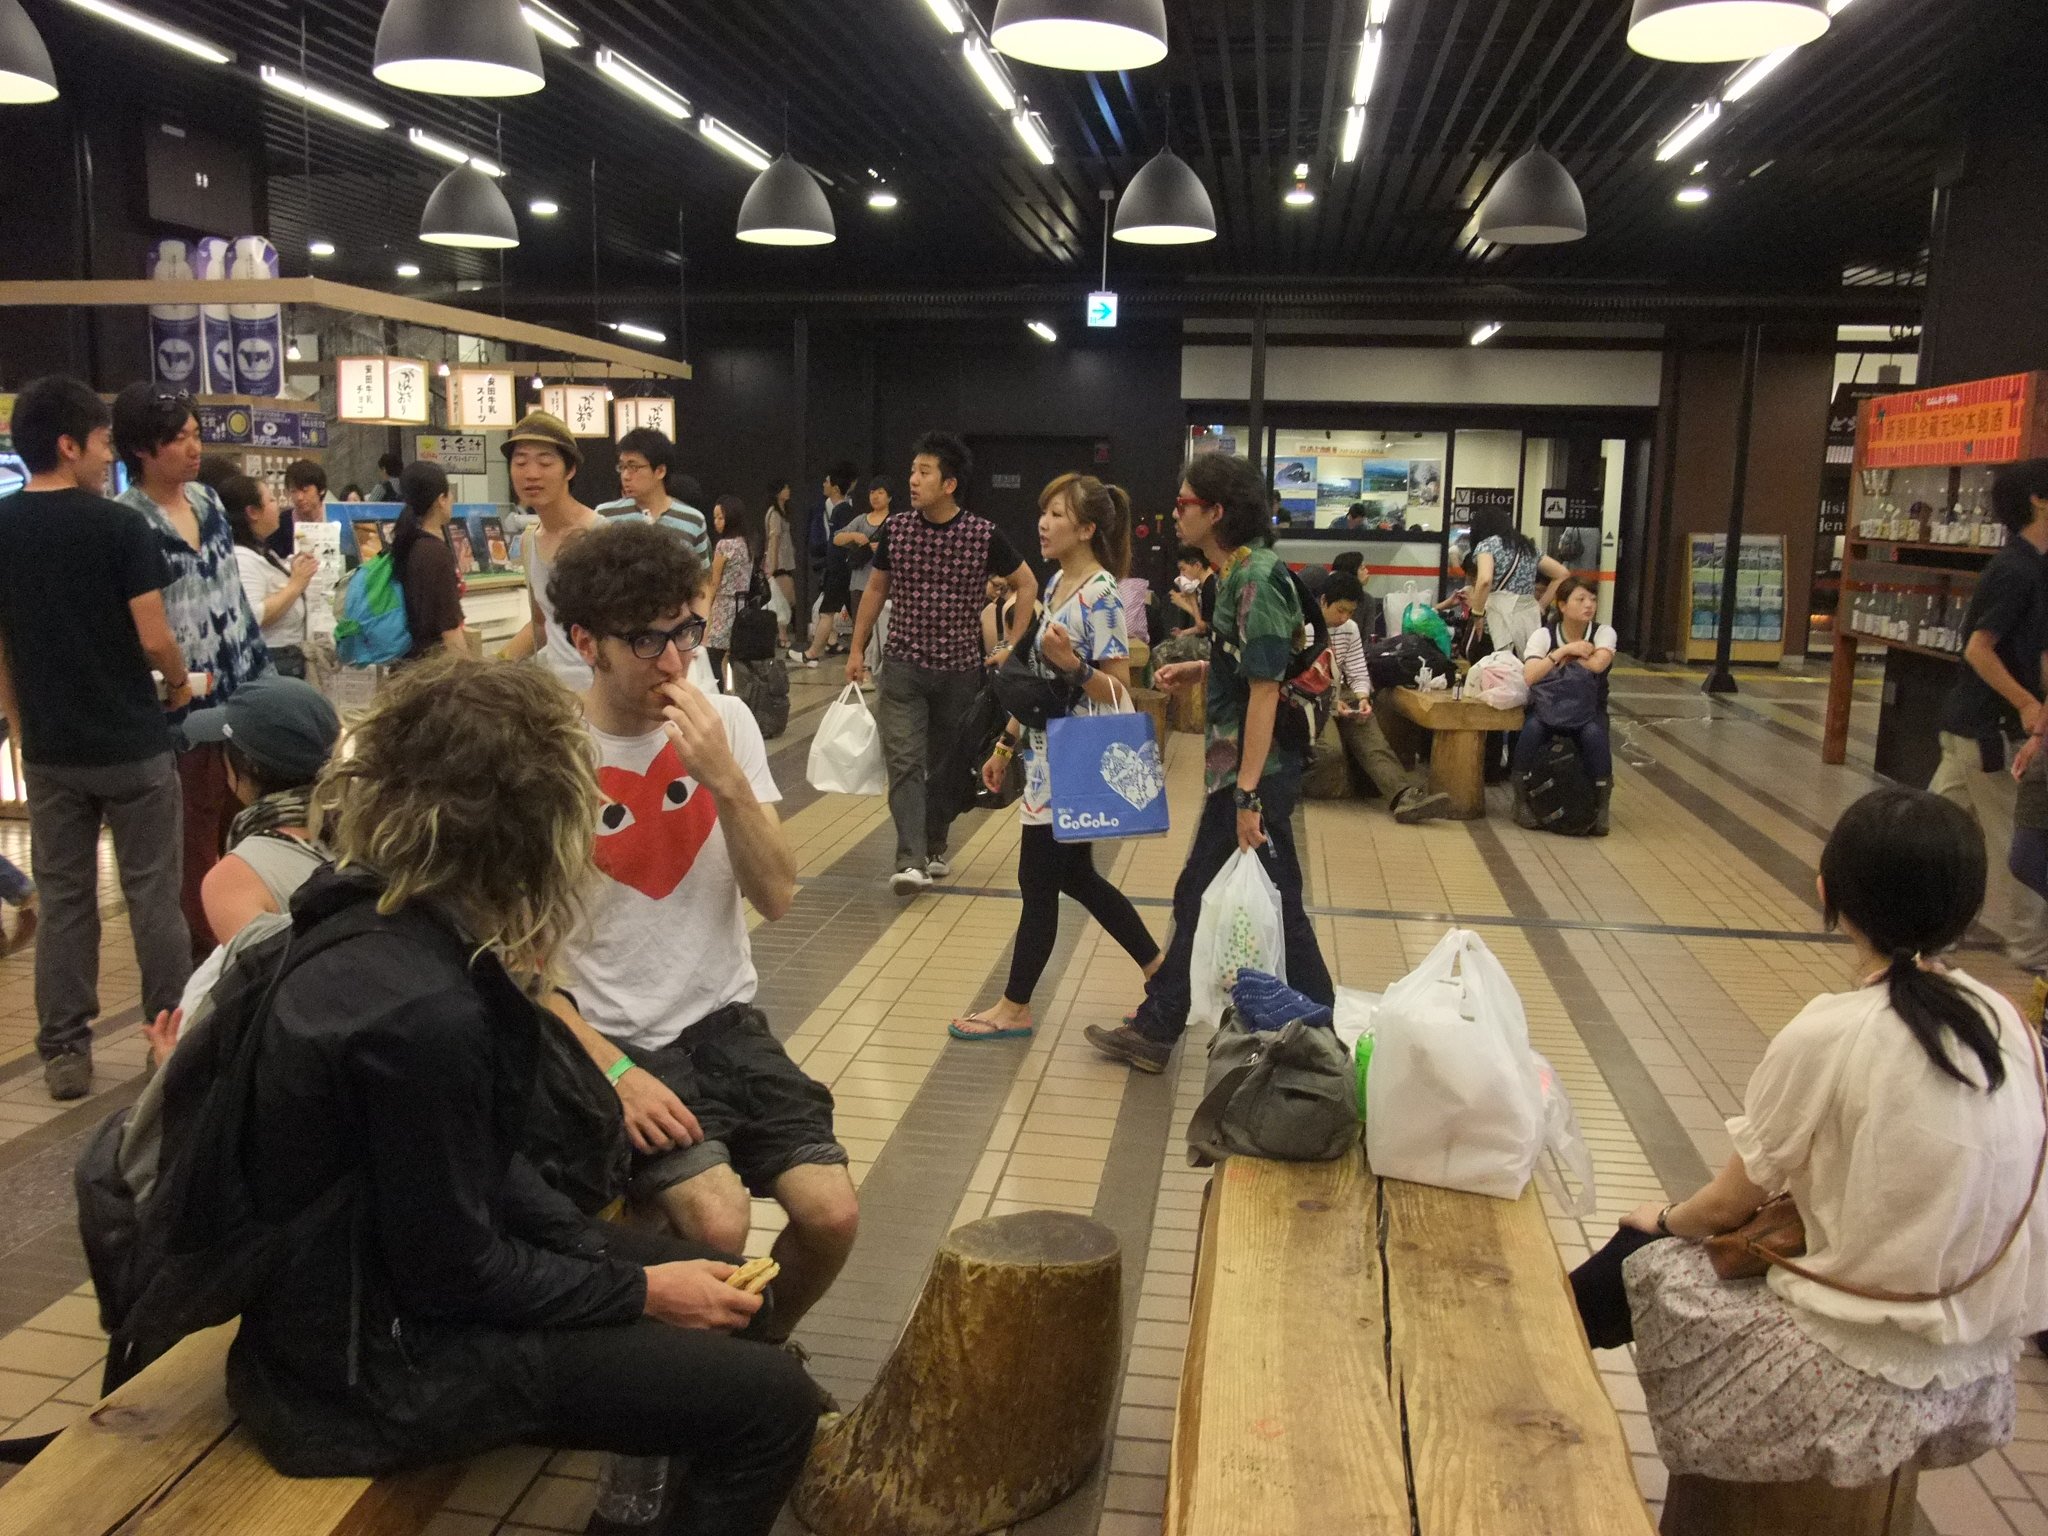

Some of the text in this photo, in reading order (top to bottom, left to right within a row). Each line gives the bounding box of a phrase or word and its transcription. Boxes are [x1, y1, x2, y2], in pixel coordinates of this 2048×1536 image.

[365, 365, 373, 404] 安田牛乳
[487, 377, 498, 415] 安田牛乳
[356, 385, 364, 414] チョコ
[477, 387, 487, 423] スイーツ
[440, 437, 481, 453] お会計
[1456, 490, 1513, 505] Visitor
[1058, 811, 1119, 829] CoCoLo
